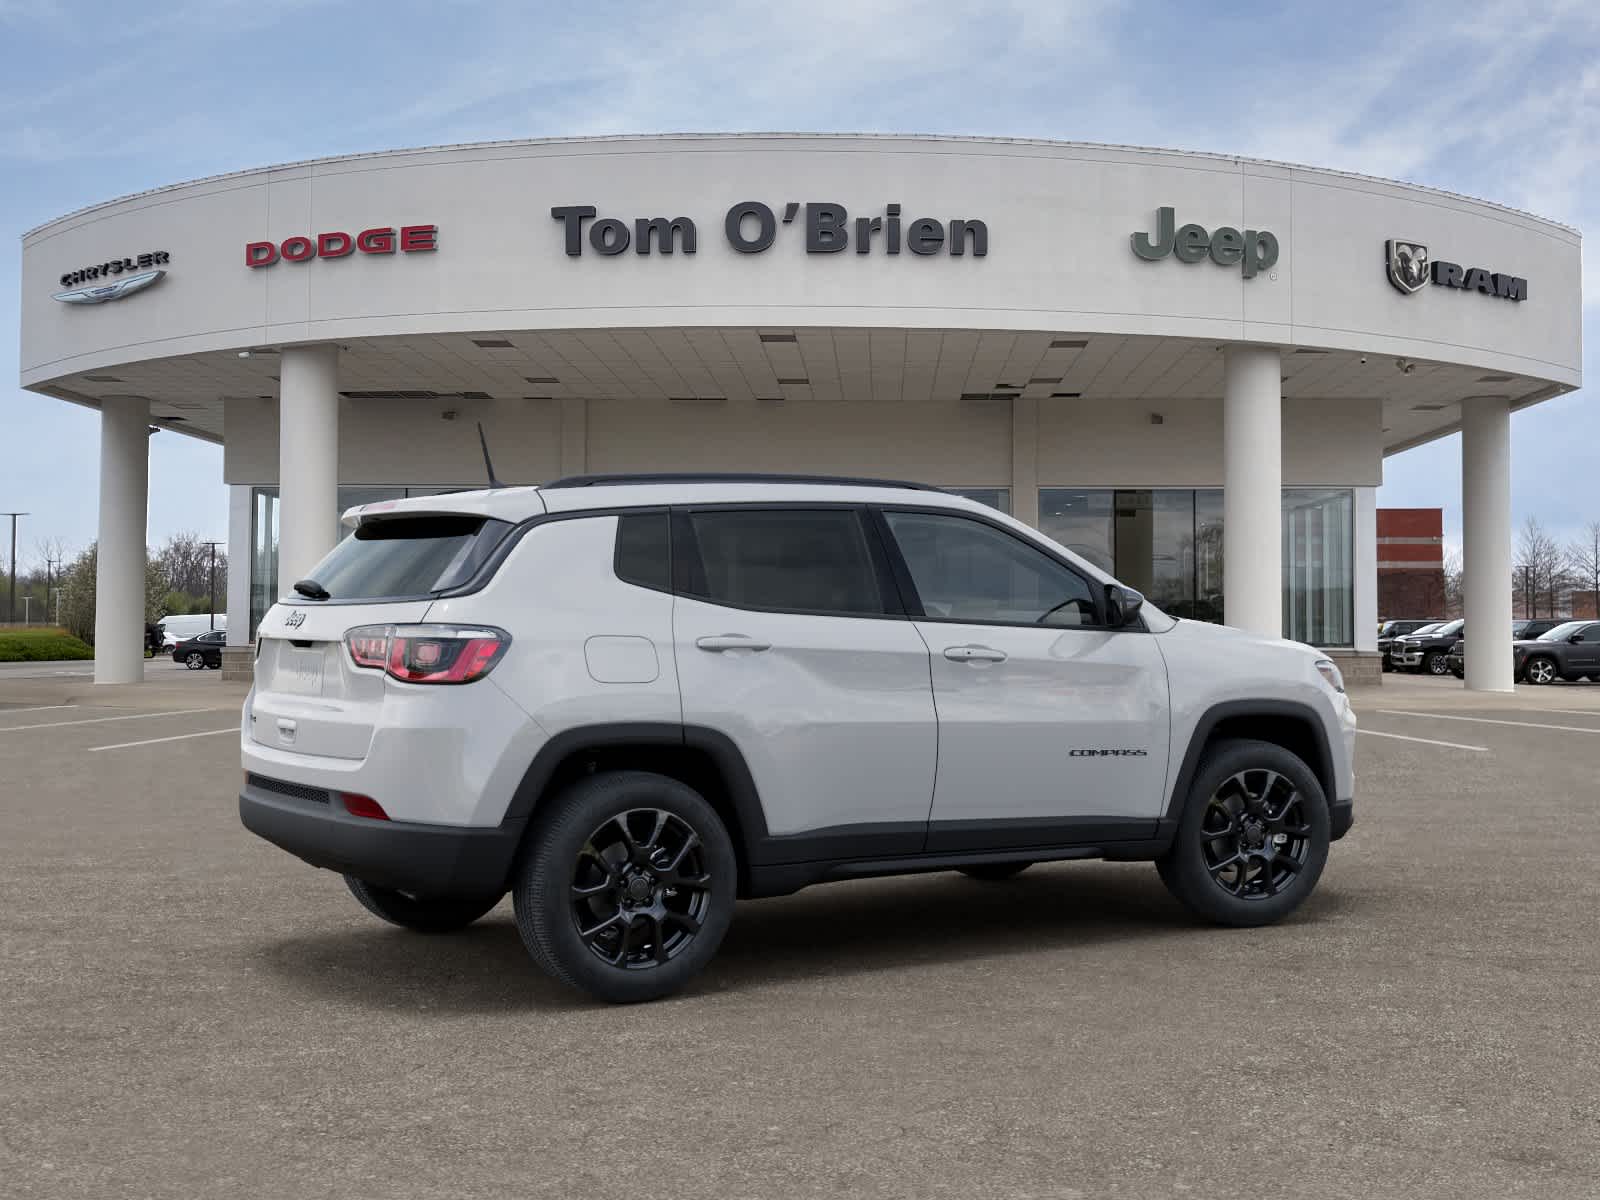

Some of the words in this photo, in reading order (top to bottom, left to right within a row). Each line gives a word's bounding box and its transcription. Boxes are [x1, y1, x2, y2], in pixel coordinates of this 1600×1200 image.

[246, 225, 438, 269] DODGE
[551, 206, 697, 256] Tom
[725, 201, 988, 257] O'Brien
[1130, 206, 1279, 279] Jeep
[60, 251, 169, 286] CHRYSLER
[1431, 260, 1528, 301] RAM
[1069, 749, 1148, 757] COMPASS
